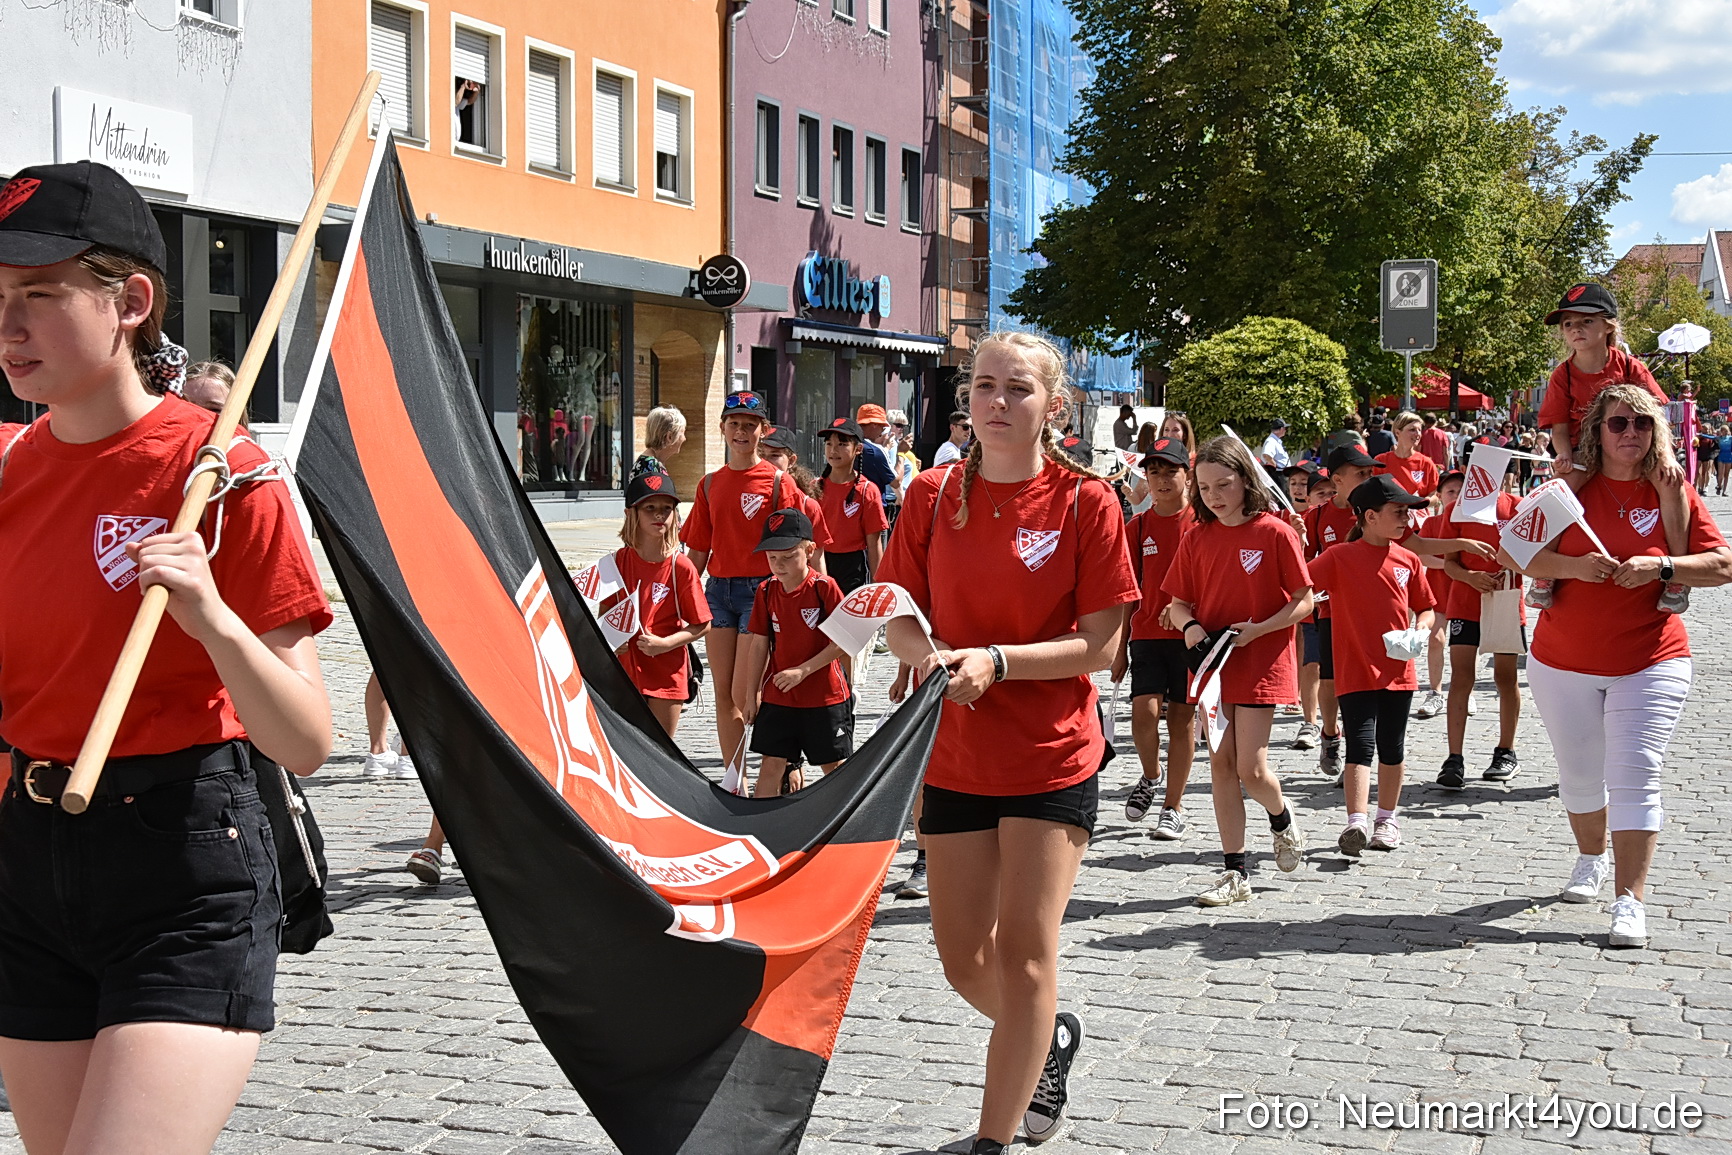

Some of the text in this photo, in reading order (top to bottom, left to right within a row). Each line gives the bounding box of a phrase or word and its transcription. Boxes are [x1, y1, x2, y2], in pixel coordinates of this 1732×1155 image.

[89, 103, 170, 166] Mittendrin
[129, 168, 161, 179] FASHION
[491, 236, 584, 280] hunkemöller
[1399, 298, 1419, 307] ZONE
[98, 517, 143, 556] BSC
[1019, 530, 1046, 551] BSC
[118, 569, 137, 585] 1950
[605, 606, 625, 629] BSC
